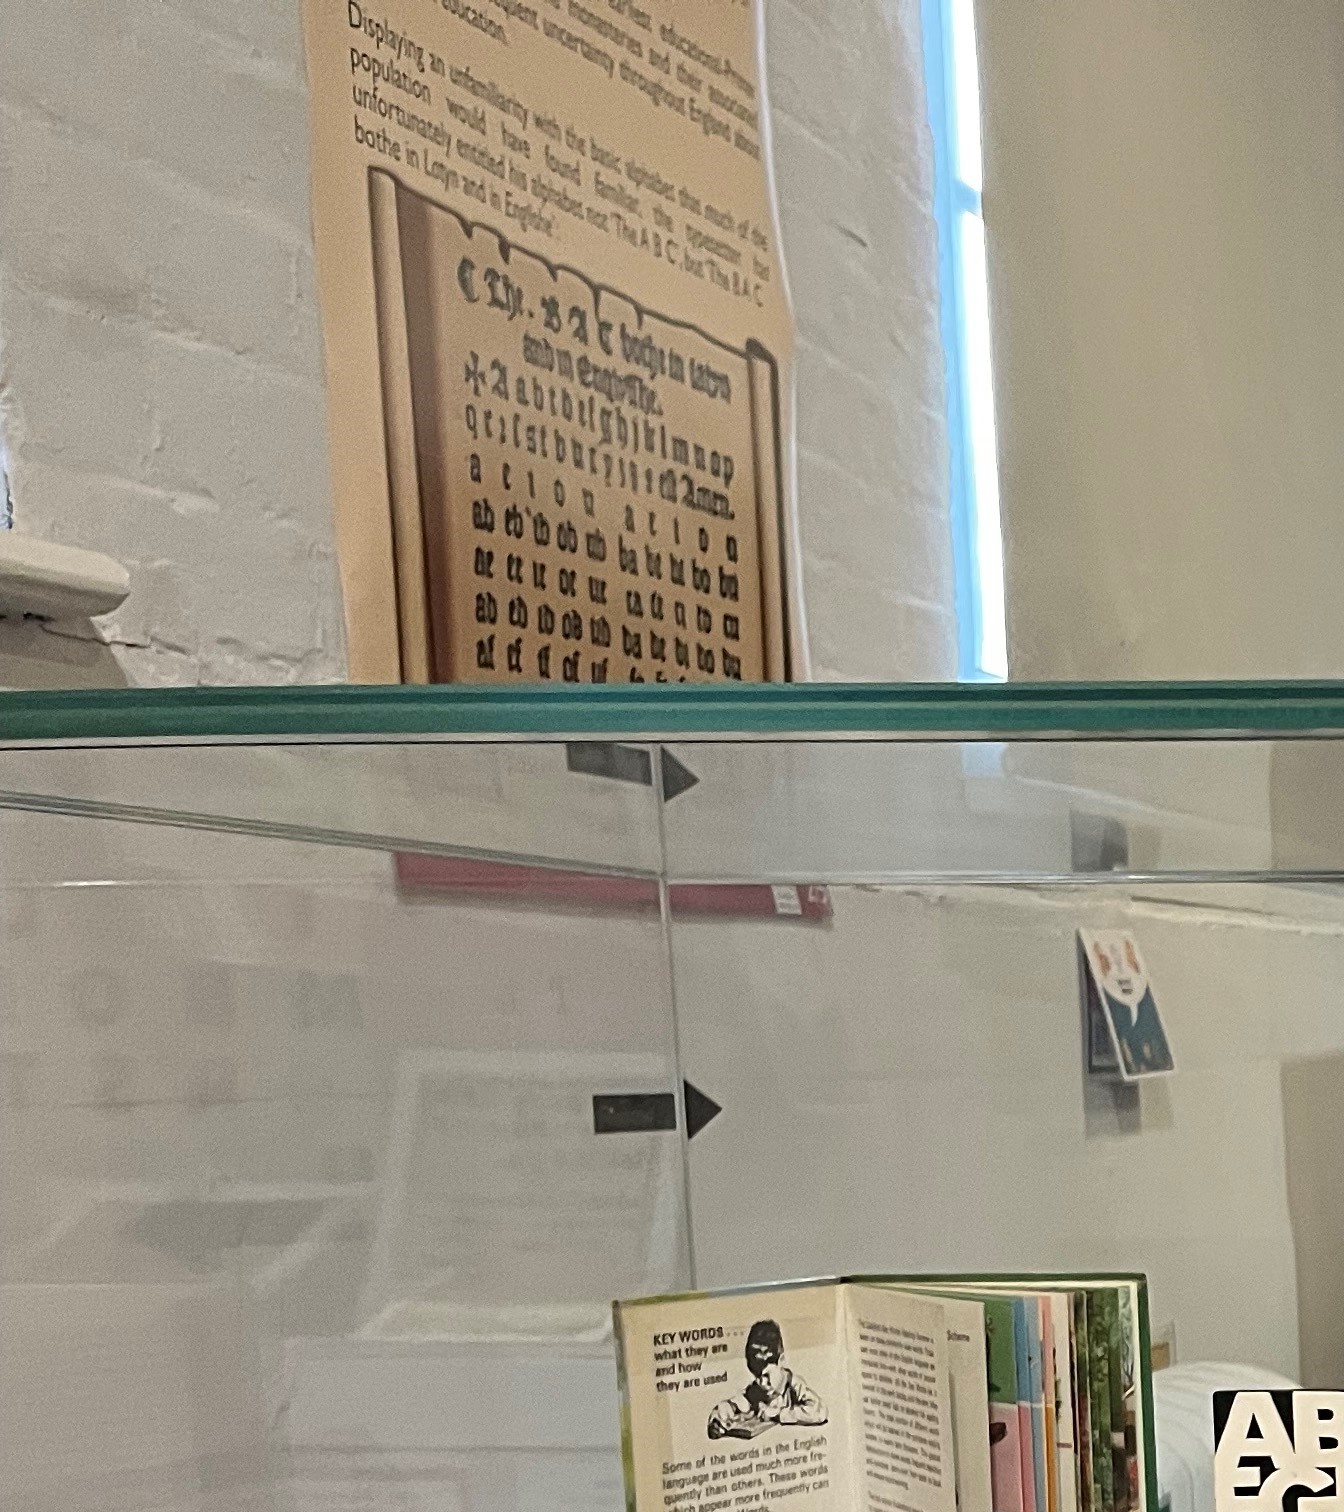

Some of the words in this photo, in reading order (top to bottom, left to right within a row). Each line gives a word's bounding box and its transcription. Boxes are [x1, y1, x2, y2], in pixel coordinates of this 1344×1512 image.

[349, 1, 425, 72] Displaying
[351, 48, 431, 105] population
[353, 85, 451, 157] unfortunately
[653, 1332, 675, 1347] KEY
[654, 1348, 683, 1361] what
[685, 1346, 709, 1359] they
[712, 1344, 728, 1354] are
[655, 1364, 675, 1377] and
[678, 1362, 702, 1373] how
[656, 1380, 680, 1392] they
[683, 1378, 700, 1389] are
[703, 1371, 728, 1385] used
[662, 1461, 692, 1475] Some
[695, 1456, 706, 1469] of
[710, 1454, 726, 1465] the
[730, 1447, 760, 1462] words
[762, 1446, 772, 1455] in
[775, 1443, 790, 1455] the
[793, 1435, 827, 1451] English
[662, 1473, 709, 1490] language
[711, 1470, 728, 1481] are
[730, 1463, 753, 1477] used
[755, 1459, 782, 1472] much
[784, 1455, 807, 1467] more
[810, 1451, 827, 1462] fre-
[663, 1488, 702, 1506] quently
[705, 1485, 728, 1497] than
[731, 1479, 765, 1491] others.
[769, 1472, 797, 1484] These
[800, 1464, 828, 1478] words
[735, 1493, 760, 1505] more
[762, 1484, 810, 1500] frequently
[812, 1479, 829, 1491] can
